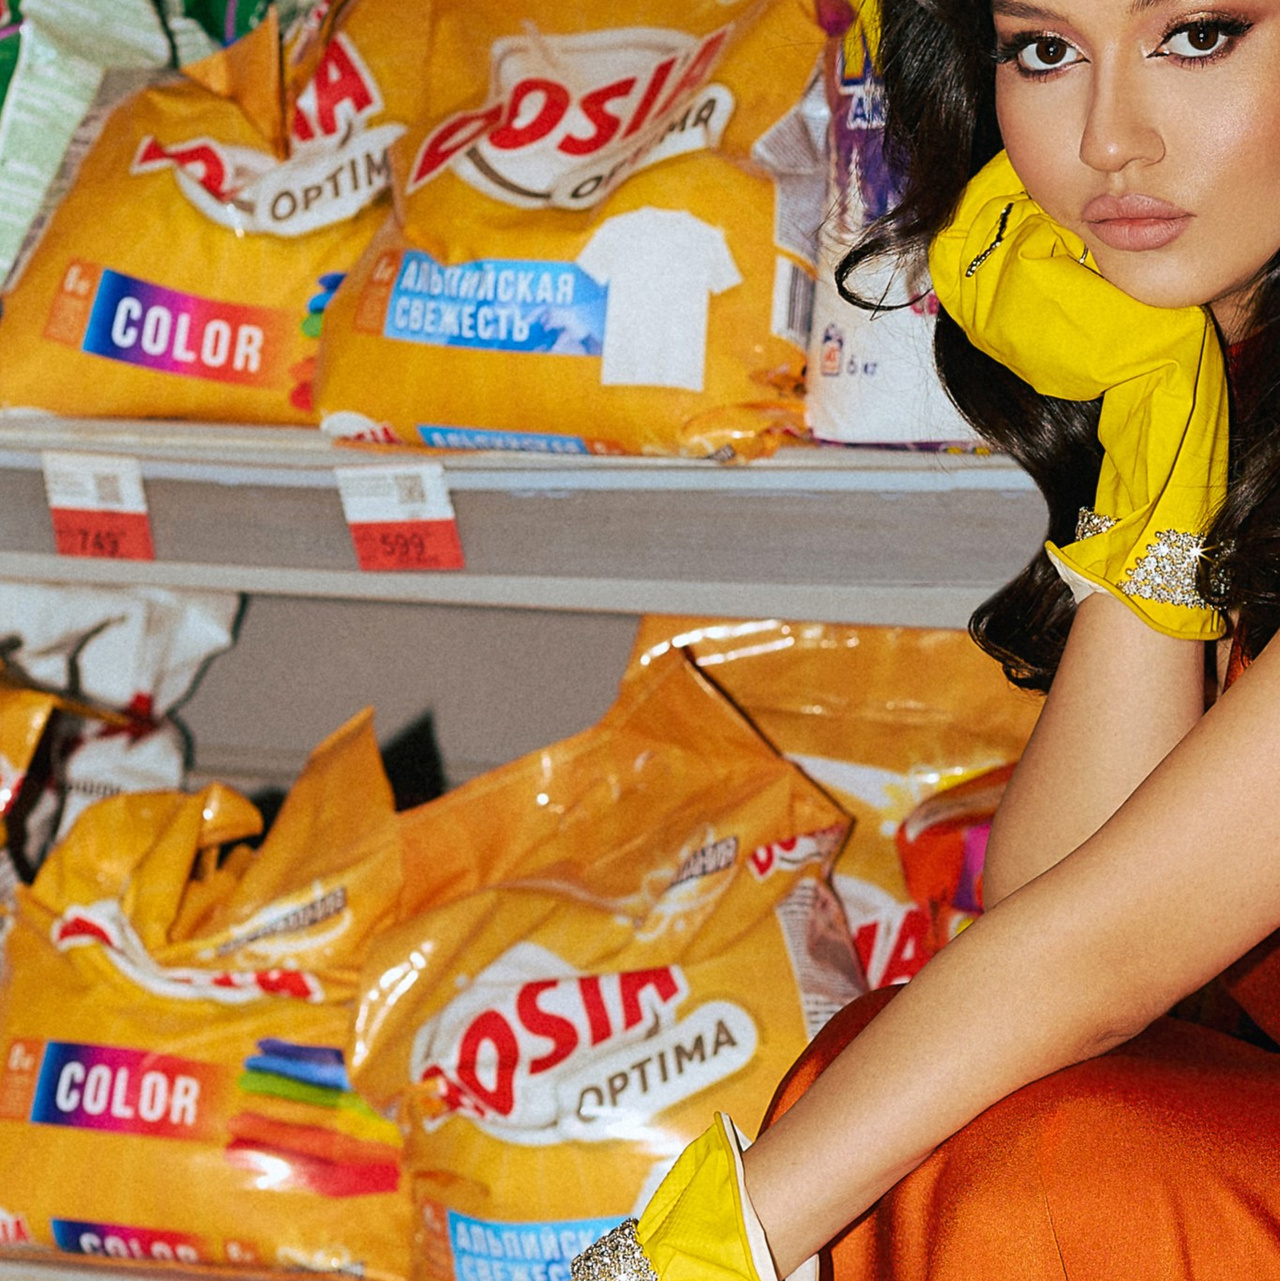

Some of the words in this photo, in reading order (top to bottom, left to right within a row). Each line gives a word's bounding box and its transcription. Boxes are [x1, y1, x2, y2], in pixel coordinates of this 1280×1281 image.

[400, 260, 576, 303] АЛЬПИЙСКАЯ
[111, 296, 264, 373] COLOR
[394, 297, 530, 342] СВЕЖЕСТЬ
[380, 535, 425, 557] 599
[576, 1019, 738, 1123] OPTIMA
[55, 1061, 200, 1127] COLOR
[455, 1221, 596, 1262] АЛЬПИЙСК
